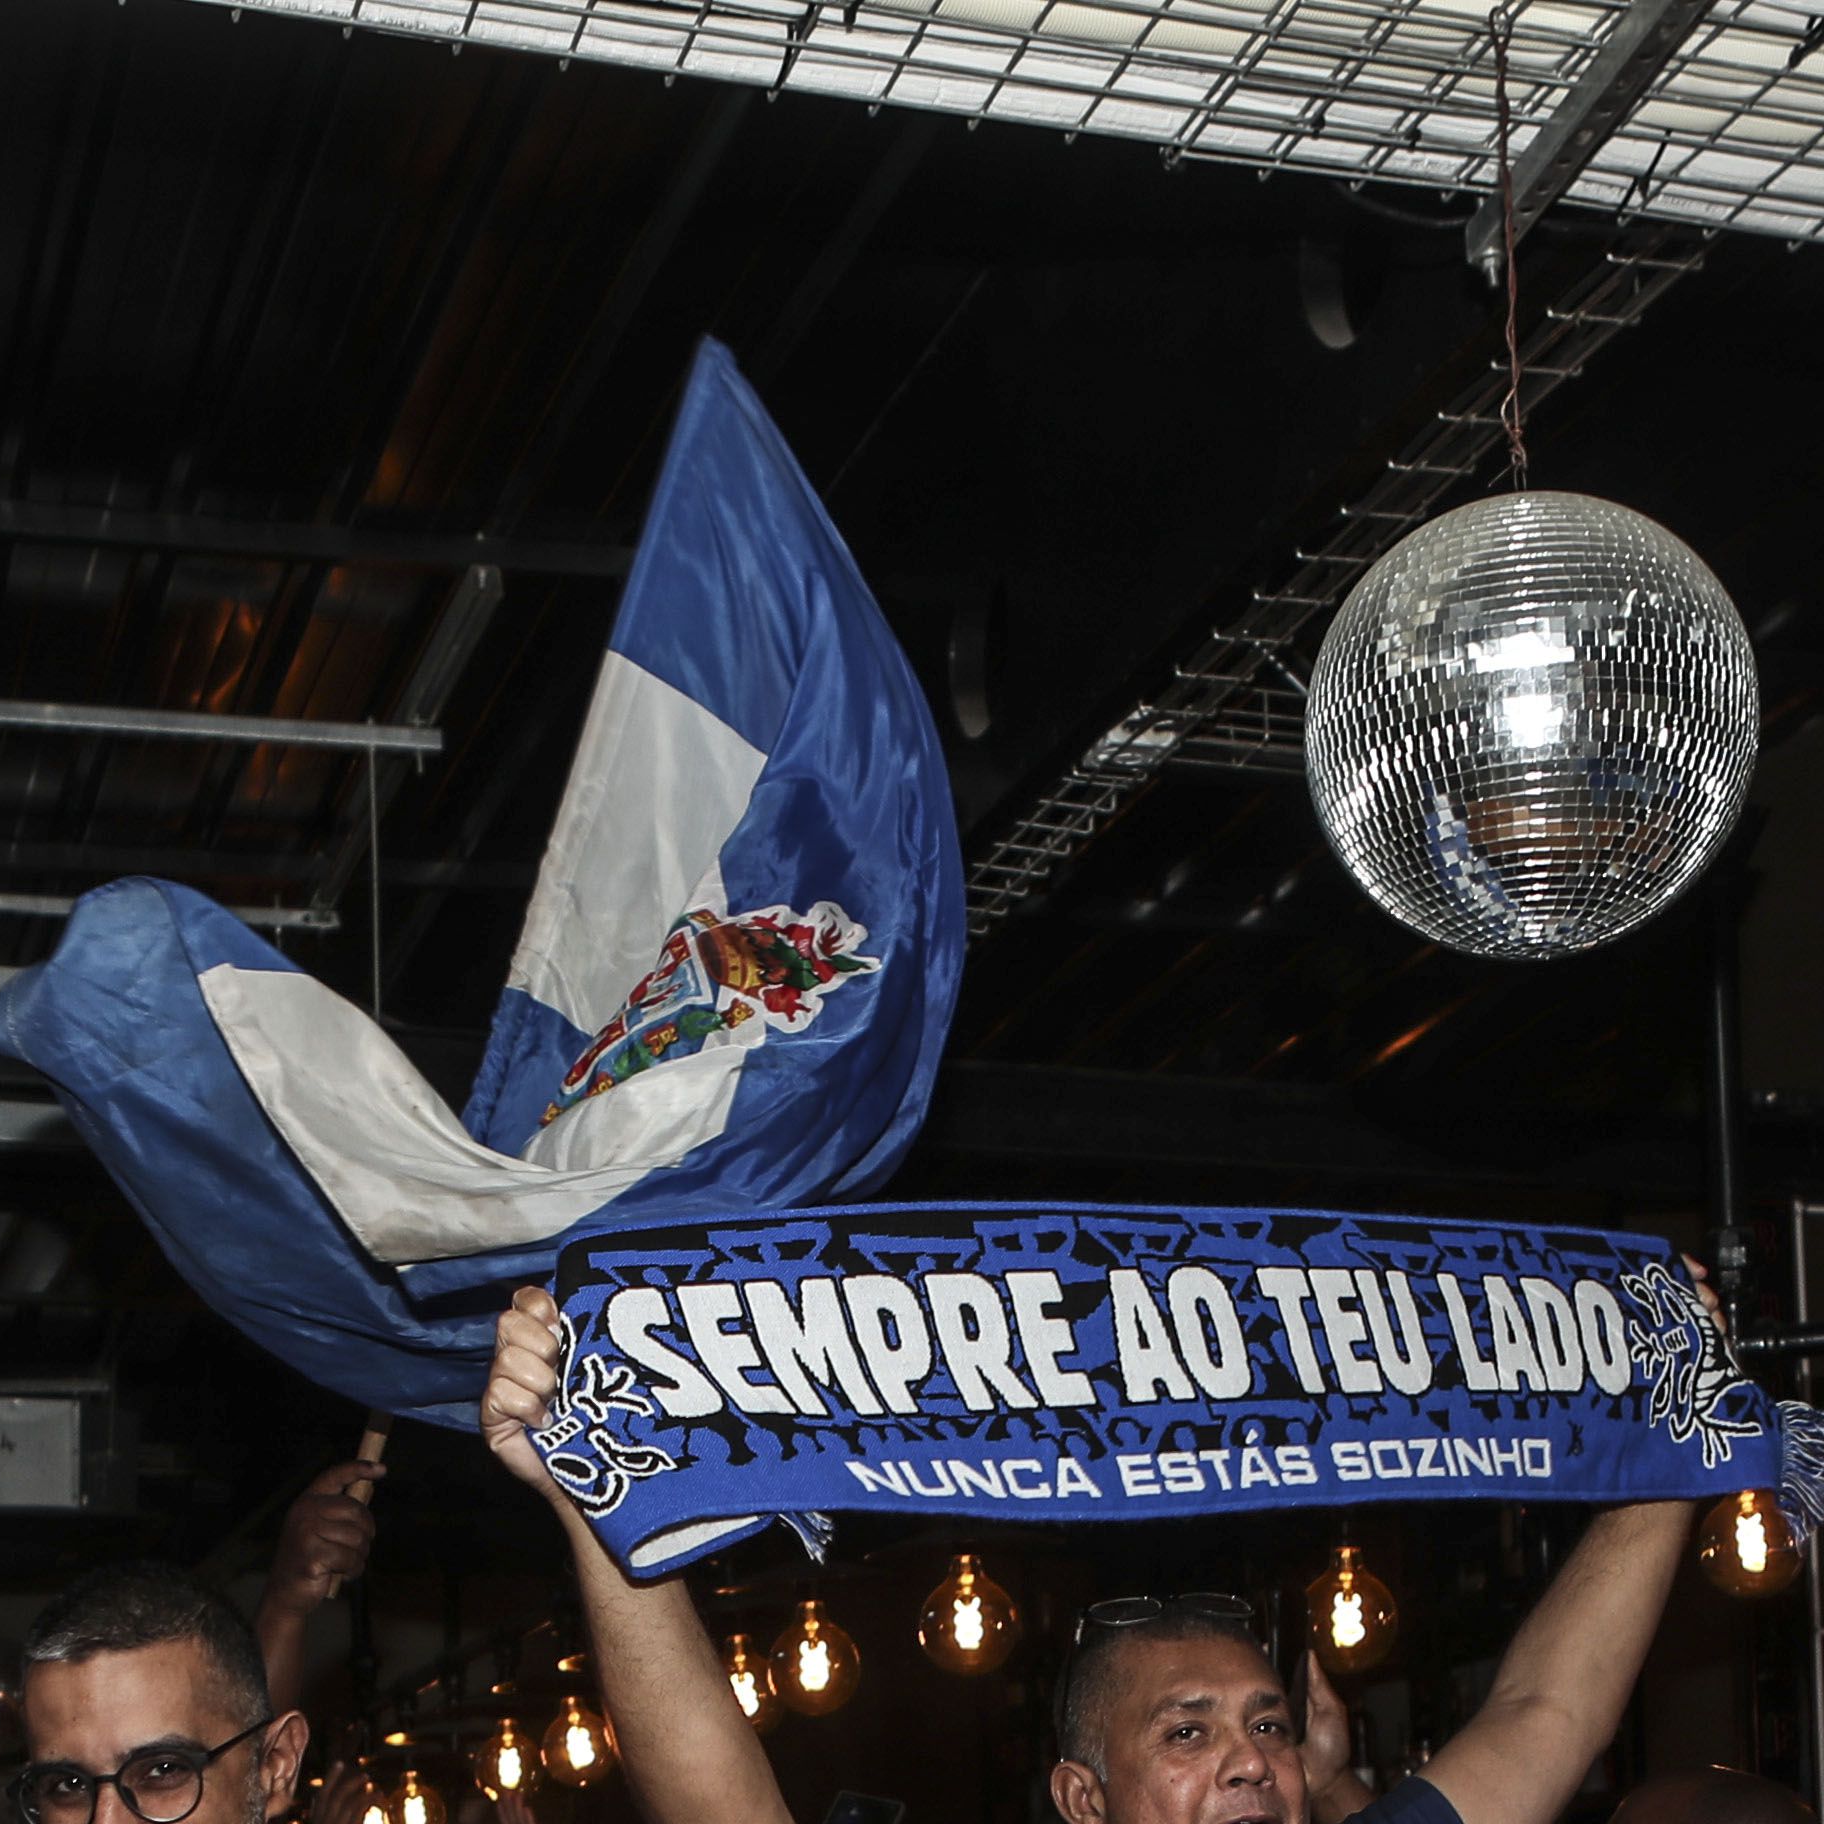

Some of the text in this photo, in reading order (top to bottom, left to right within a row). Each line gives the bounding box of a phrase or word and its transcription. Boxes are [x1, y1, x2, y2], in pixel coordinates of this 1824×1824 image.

[605, 1264, 1632, 1417] SEMPRE AO TEU LADO
[844, 1428, 1552, 1499] NUNCA ESTÁS SOZINHO
